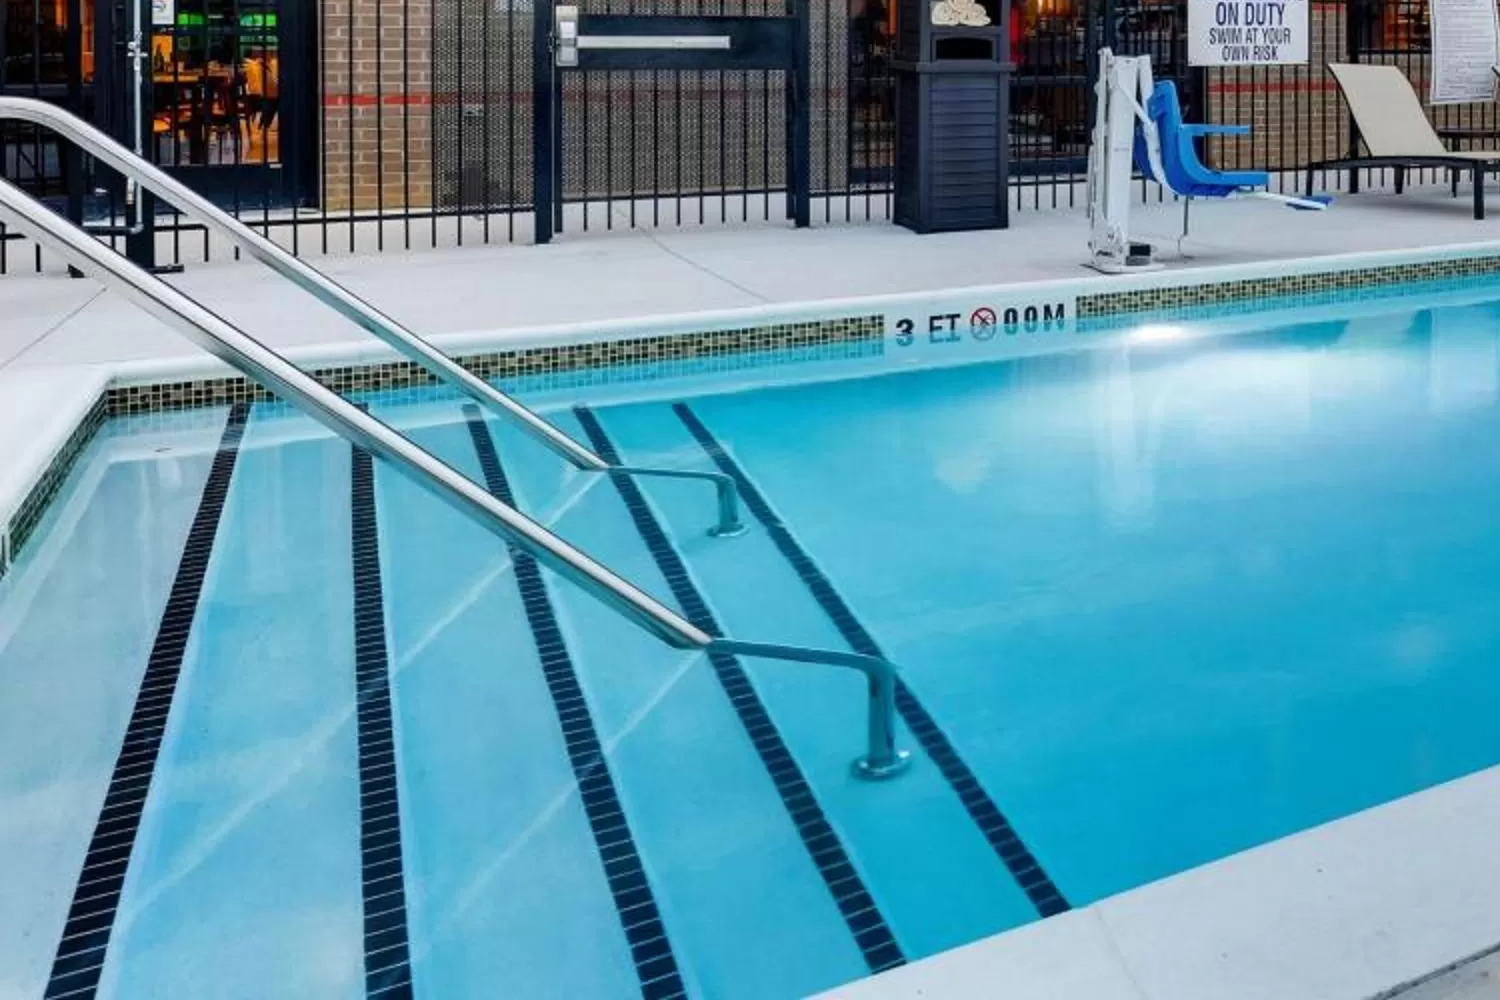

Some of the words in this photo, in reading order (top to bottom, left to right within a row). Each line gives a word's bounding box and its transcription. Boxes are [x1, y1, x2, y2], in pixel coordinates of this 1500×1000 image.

[1216, 2, 1239, 26] ON
[1245, 2, 1285, 26] DUTY
[1209, 28, 1241, 45] SWIM
[1246, 28, 1259, 45] AT
[1262, 28, 1291, 45] YOUR
[1222, 45, 1249, 62] OWN
[1253, 45, 1279, 61] RISK
